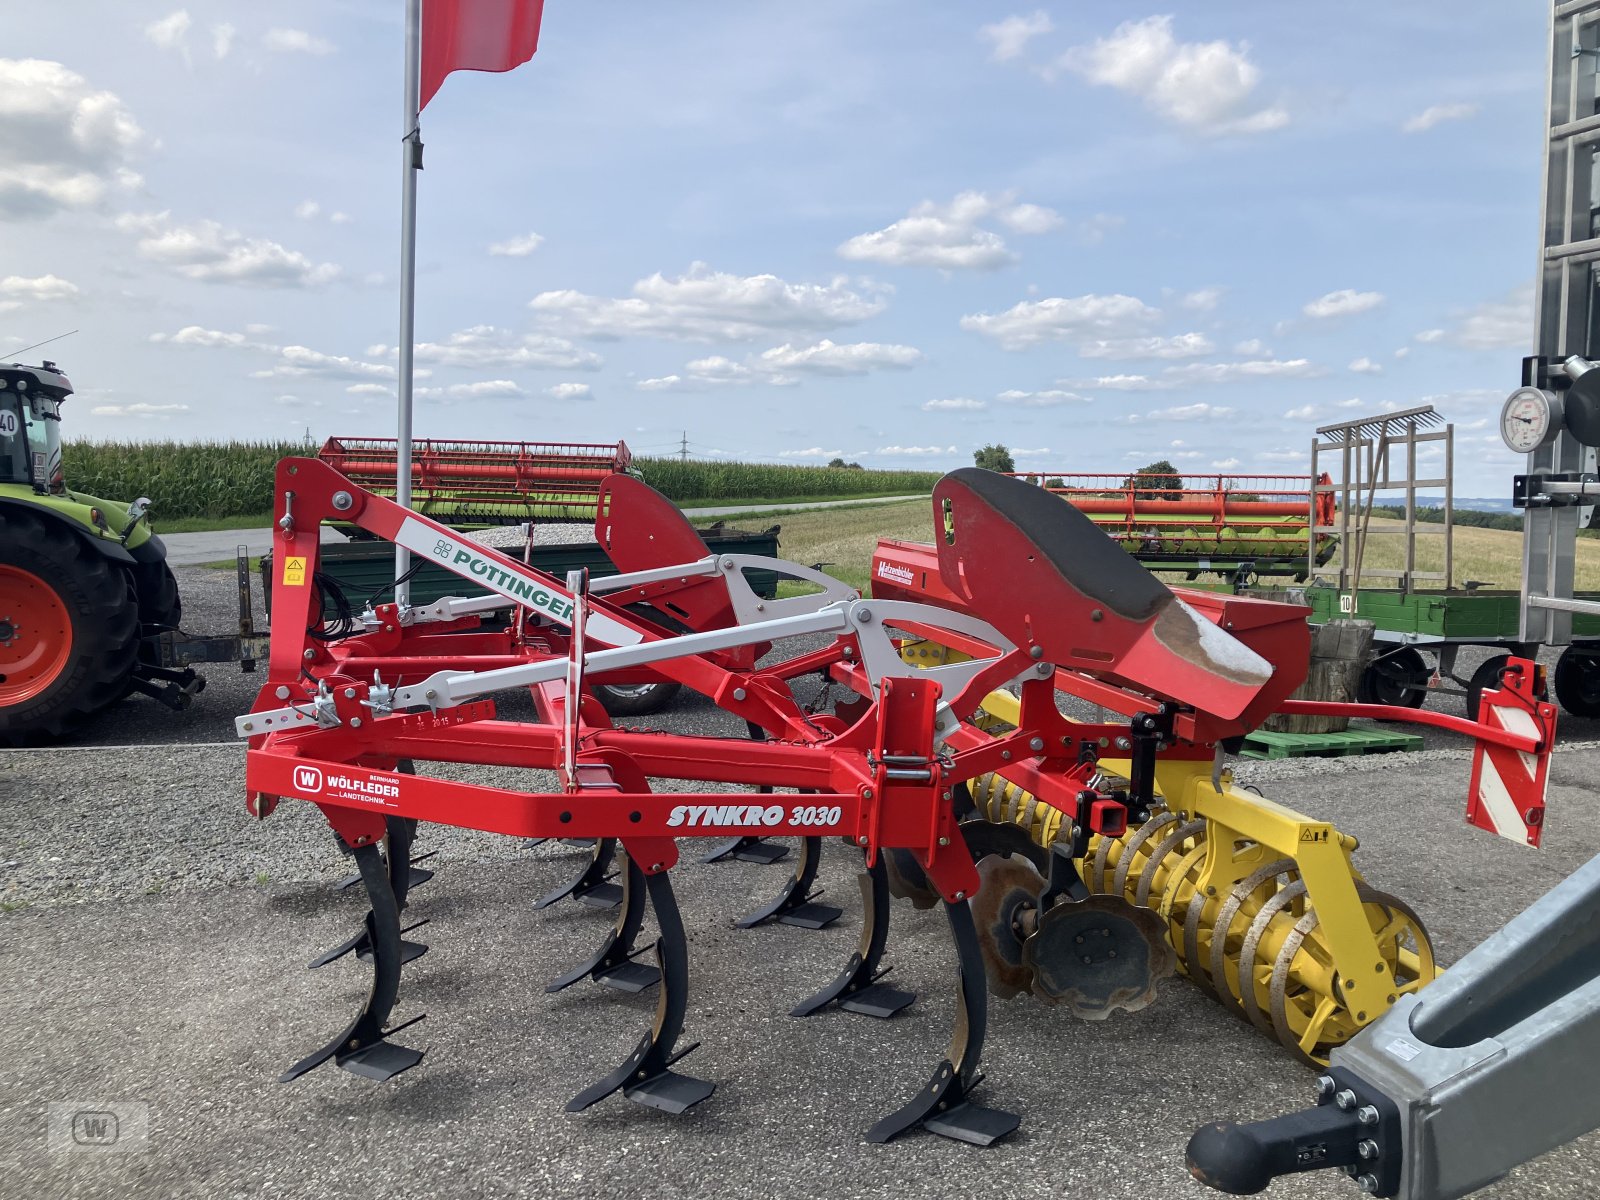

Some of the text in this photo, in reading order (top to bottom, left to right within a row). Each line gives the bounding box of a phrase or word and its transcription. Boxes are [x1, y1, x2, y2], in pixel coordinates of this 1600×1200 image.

[0, 415, 15, 432] 40
[300, 771, 316, 787] W
[327, 775, 399, 797] WÖLFLEDER
[369, 775, 400, 784] BERNHARD
[338, 791, 385, 804] LANDTECHNIK
[666, 805, 842, 826] SYNKRO 3030
